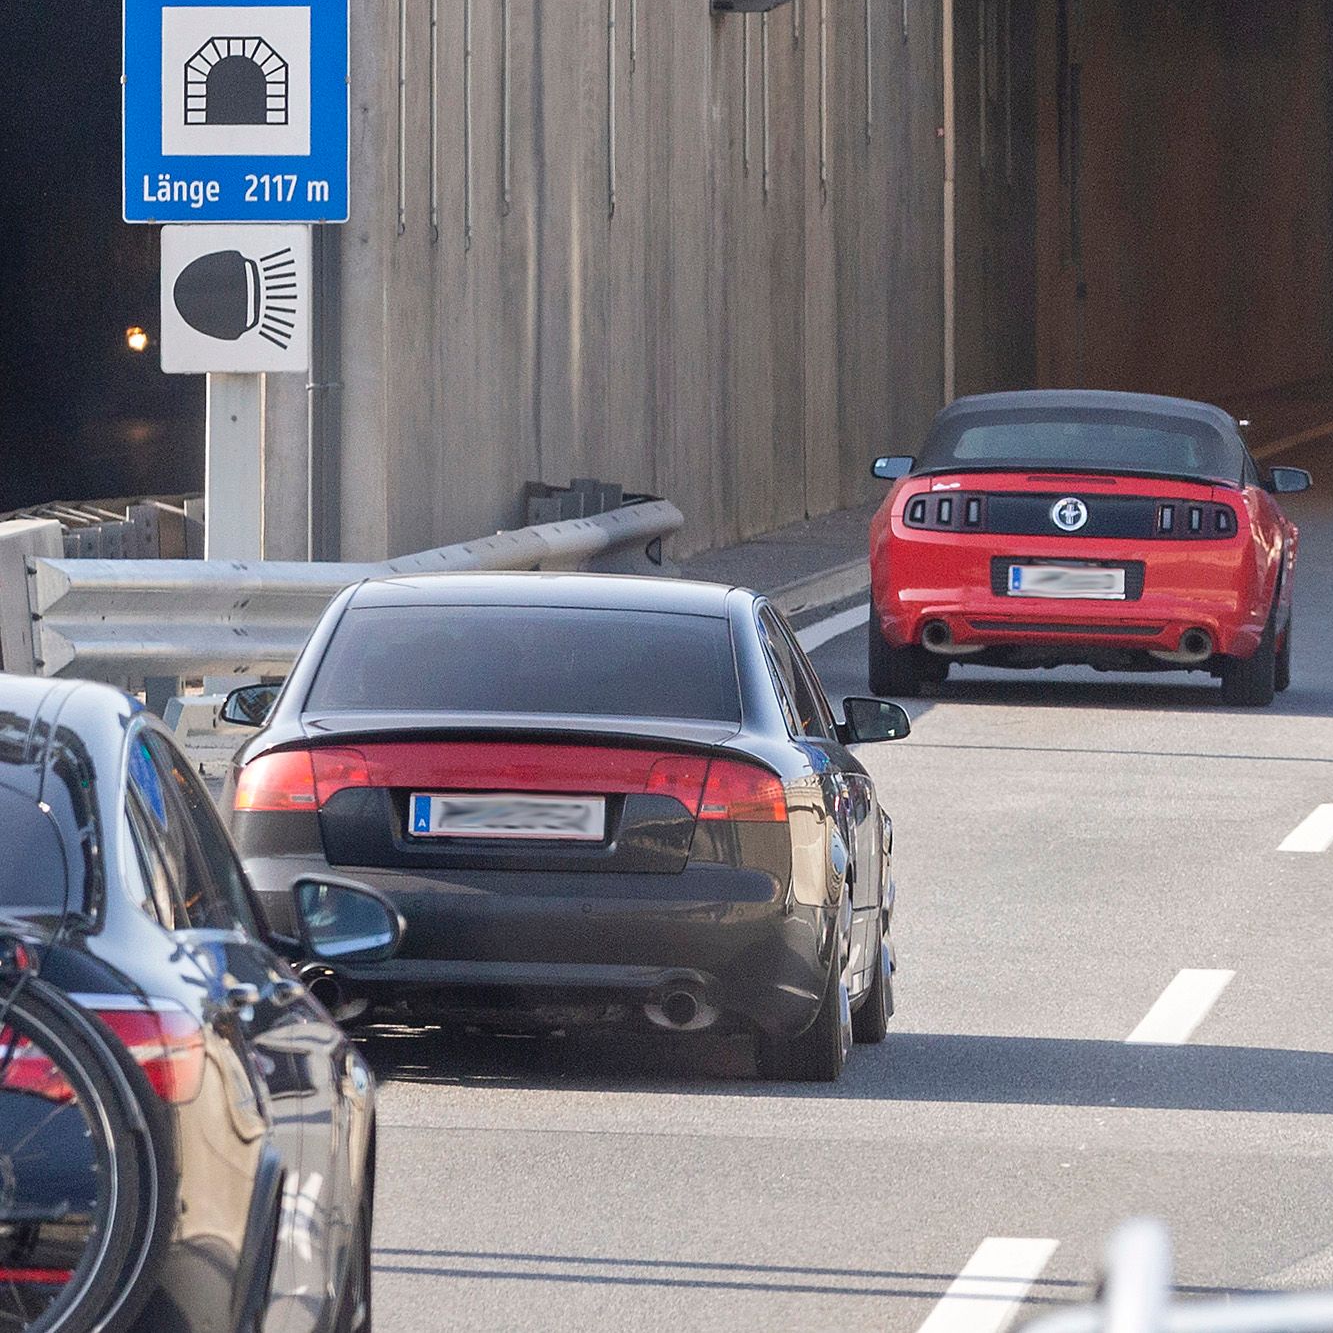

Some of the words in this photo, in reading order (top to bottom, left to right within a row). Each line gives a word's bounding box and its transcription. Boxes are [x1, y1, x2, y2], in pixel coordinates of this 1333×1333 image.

[143, 173, 220, 209] Länge
[244, 174, 298, 202] 2117
[307, 180, 329, 202] m
